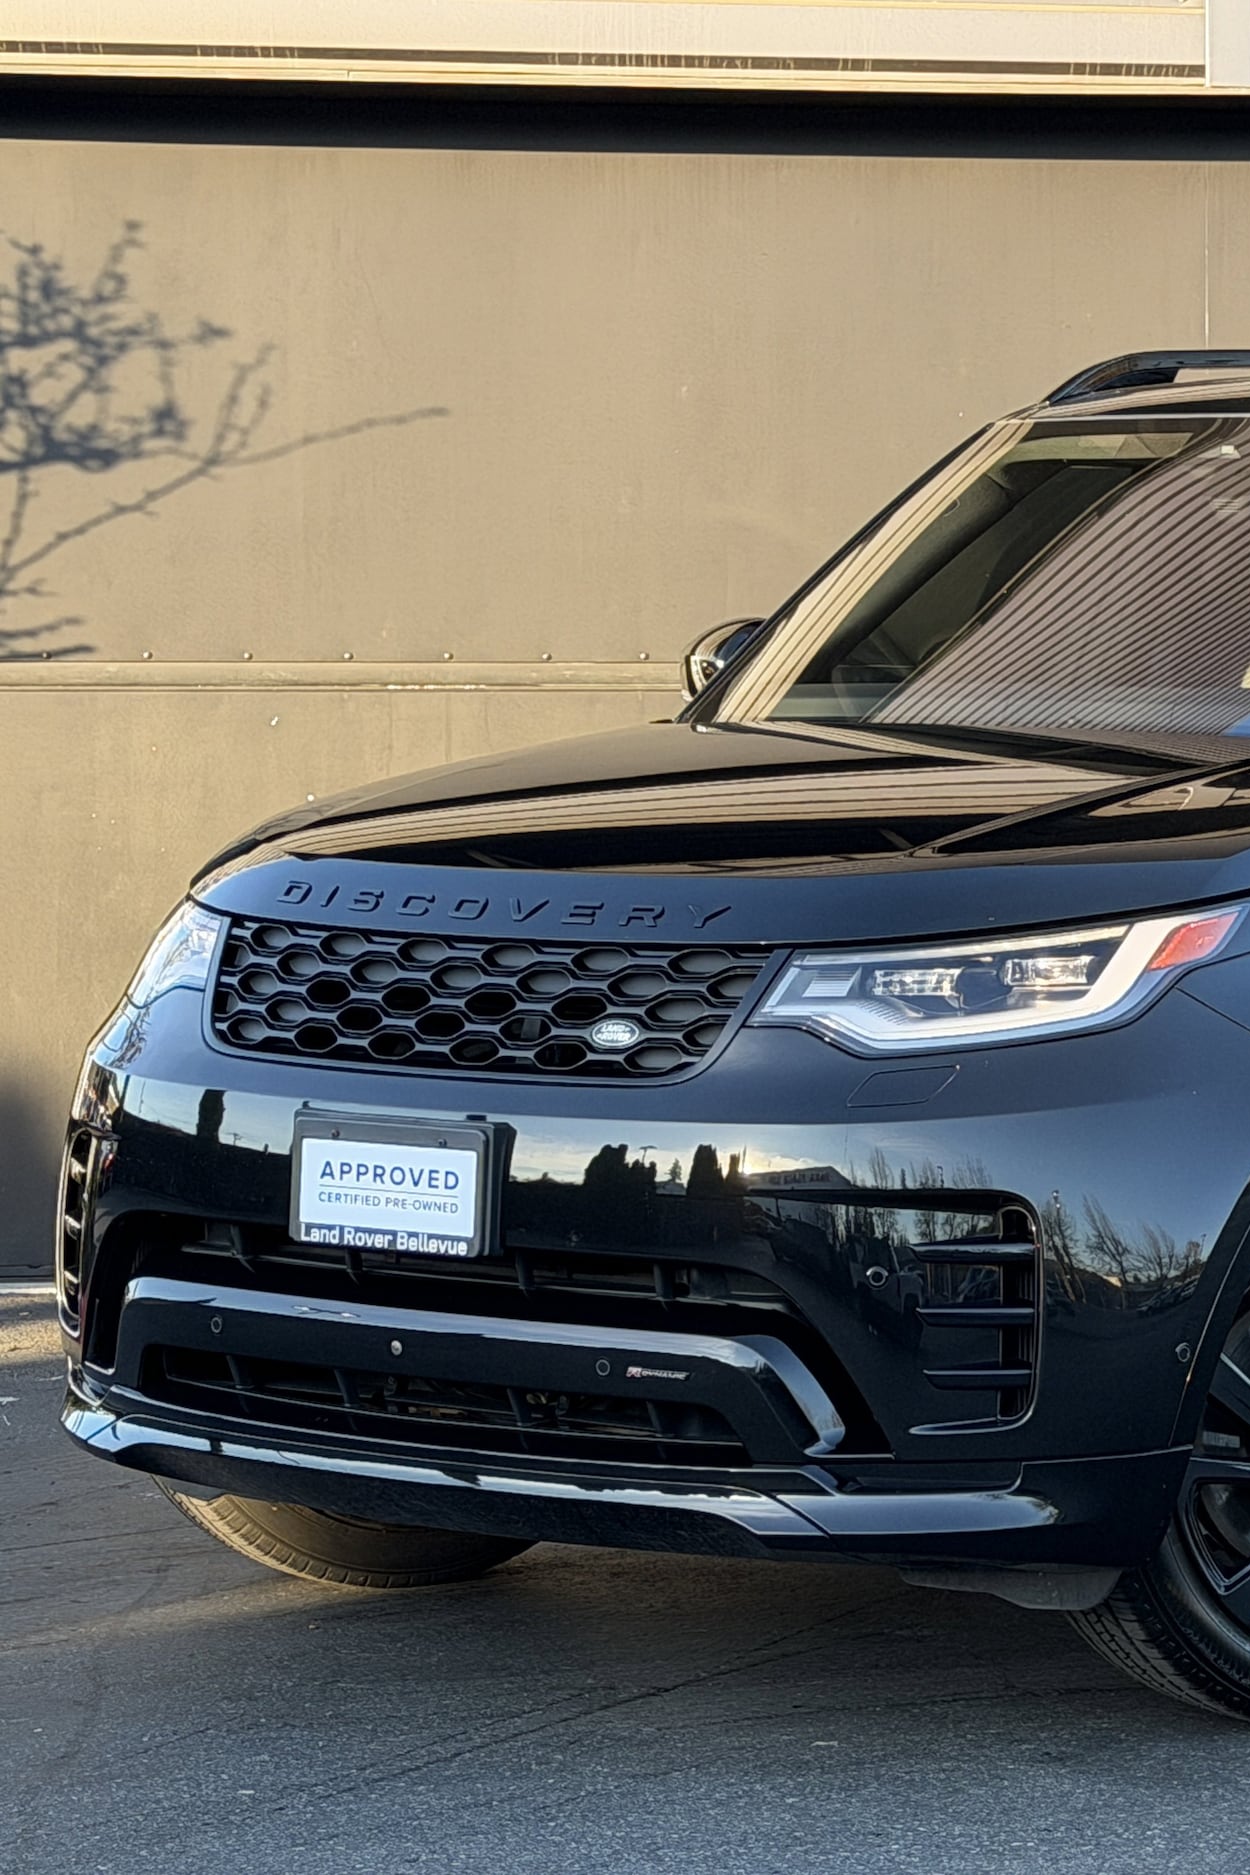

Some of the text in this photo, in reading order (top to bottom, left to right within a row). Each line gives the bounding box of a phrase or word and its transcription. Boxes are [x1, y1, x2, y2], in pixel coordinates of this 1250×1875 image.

[276, 880, 732, 929] DISCOVERY
[319, 1160, 460, 1190] APPROVED
[318, 1191, 459, 1214] CERTIFIED PRE-OWNED
[301, 1223, 468, 1256] Land Rover Bellevue
